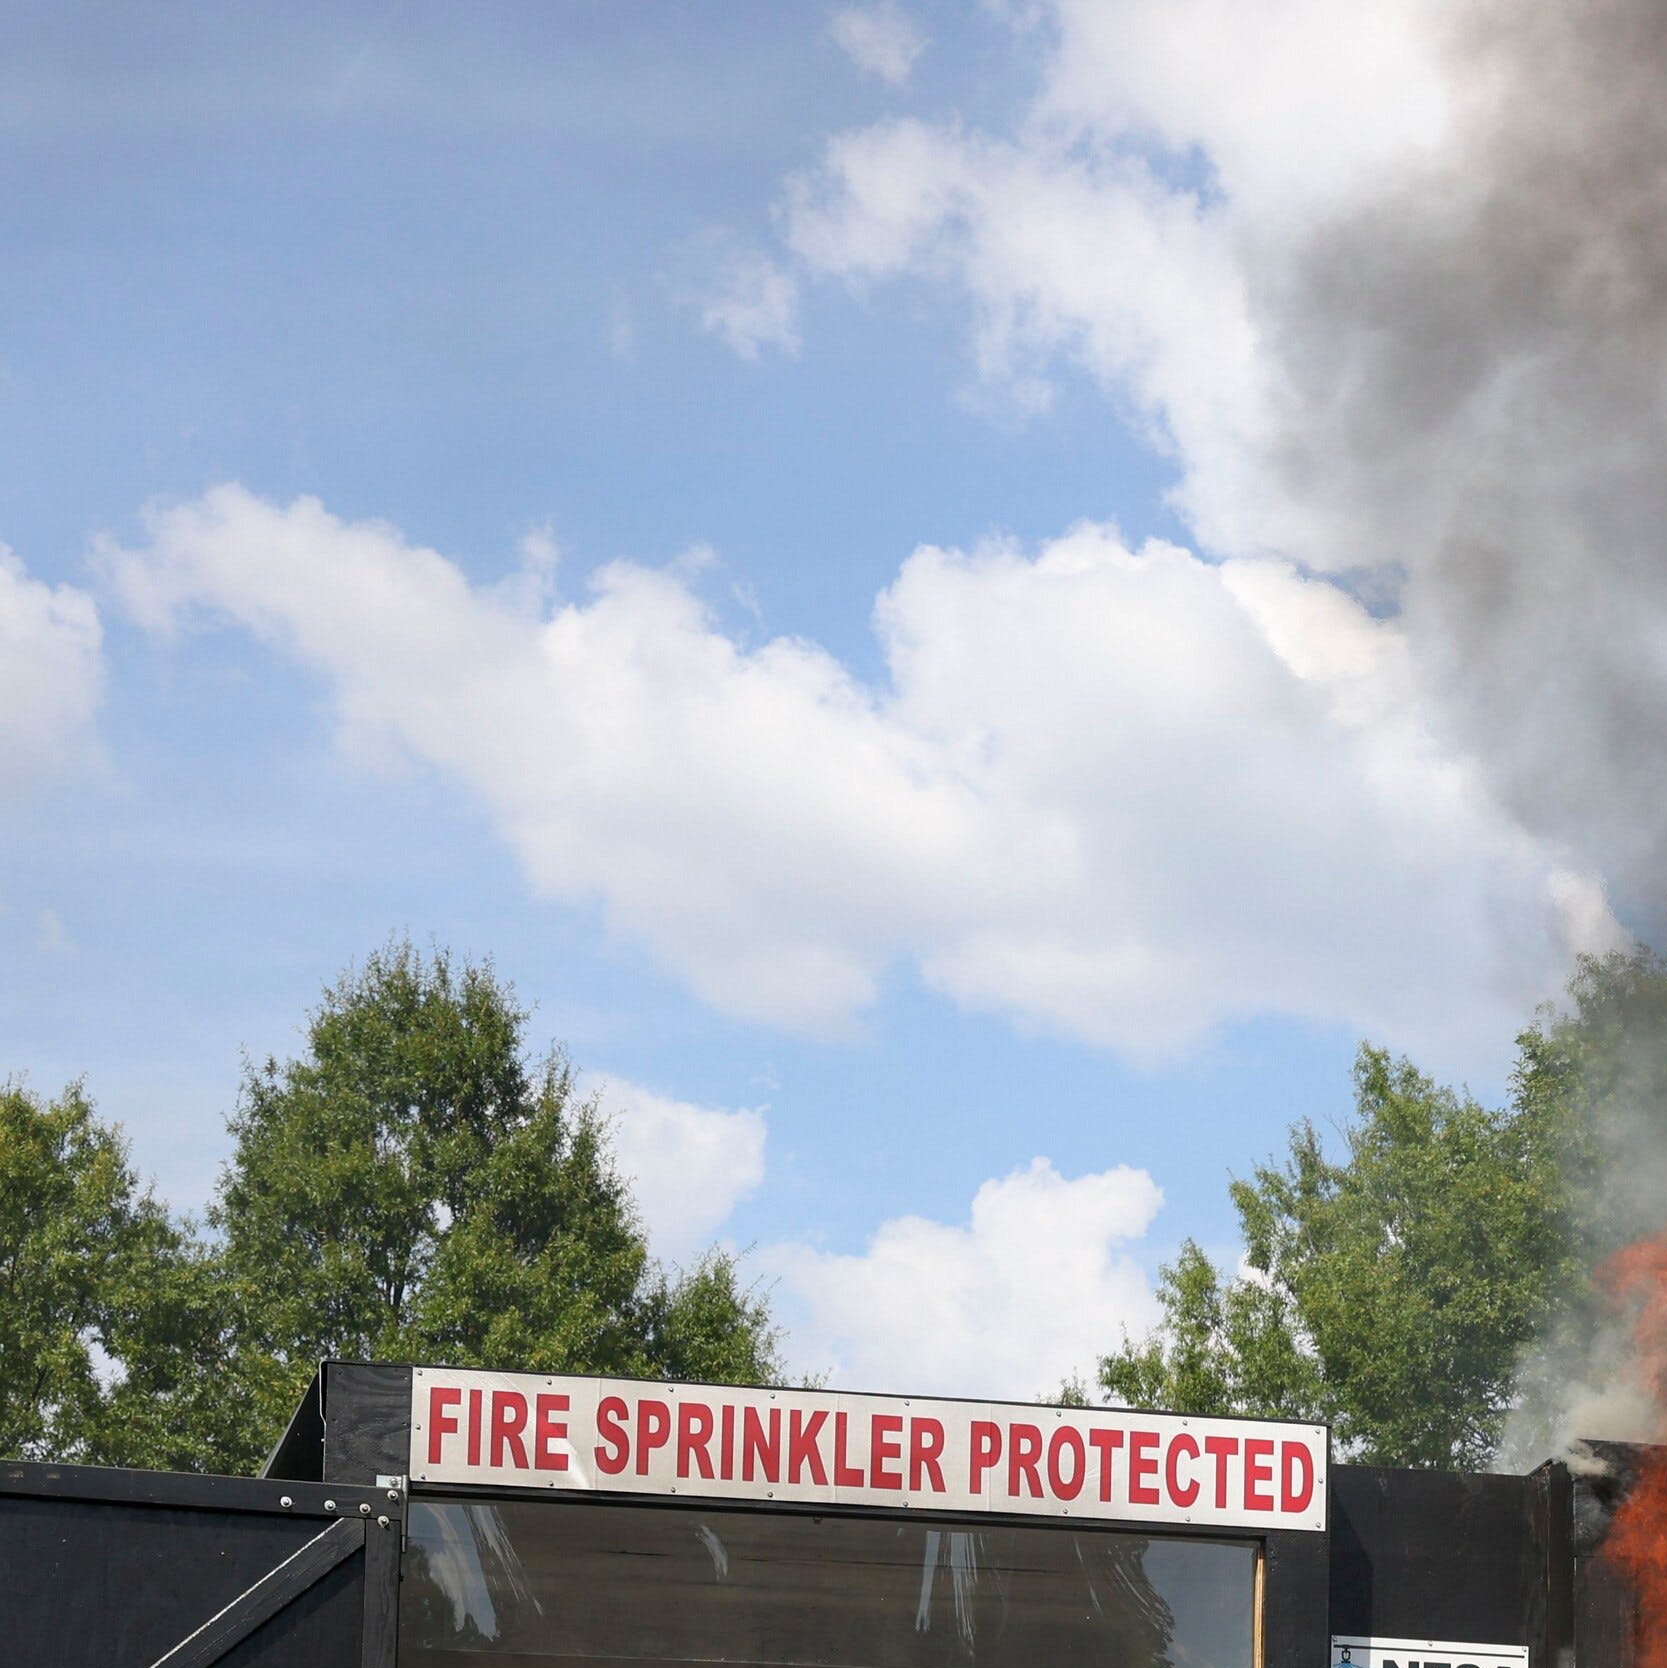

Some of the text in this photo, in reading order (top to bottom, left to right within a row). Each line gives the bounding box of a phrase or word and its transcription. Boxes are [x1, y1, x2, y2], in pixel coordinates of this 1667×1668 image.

[428, 1387, 1314, 1513] FIRE SPRINKLER PROTECTED
